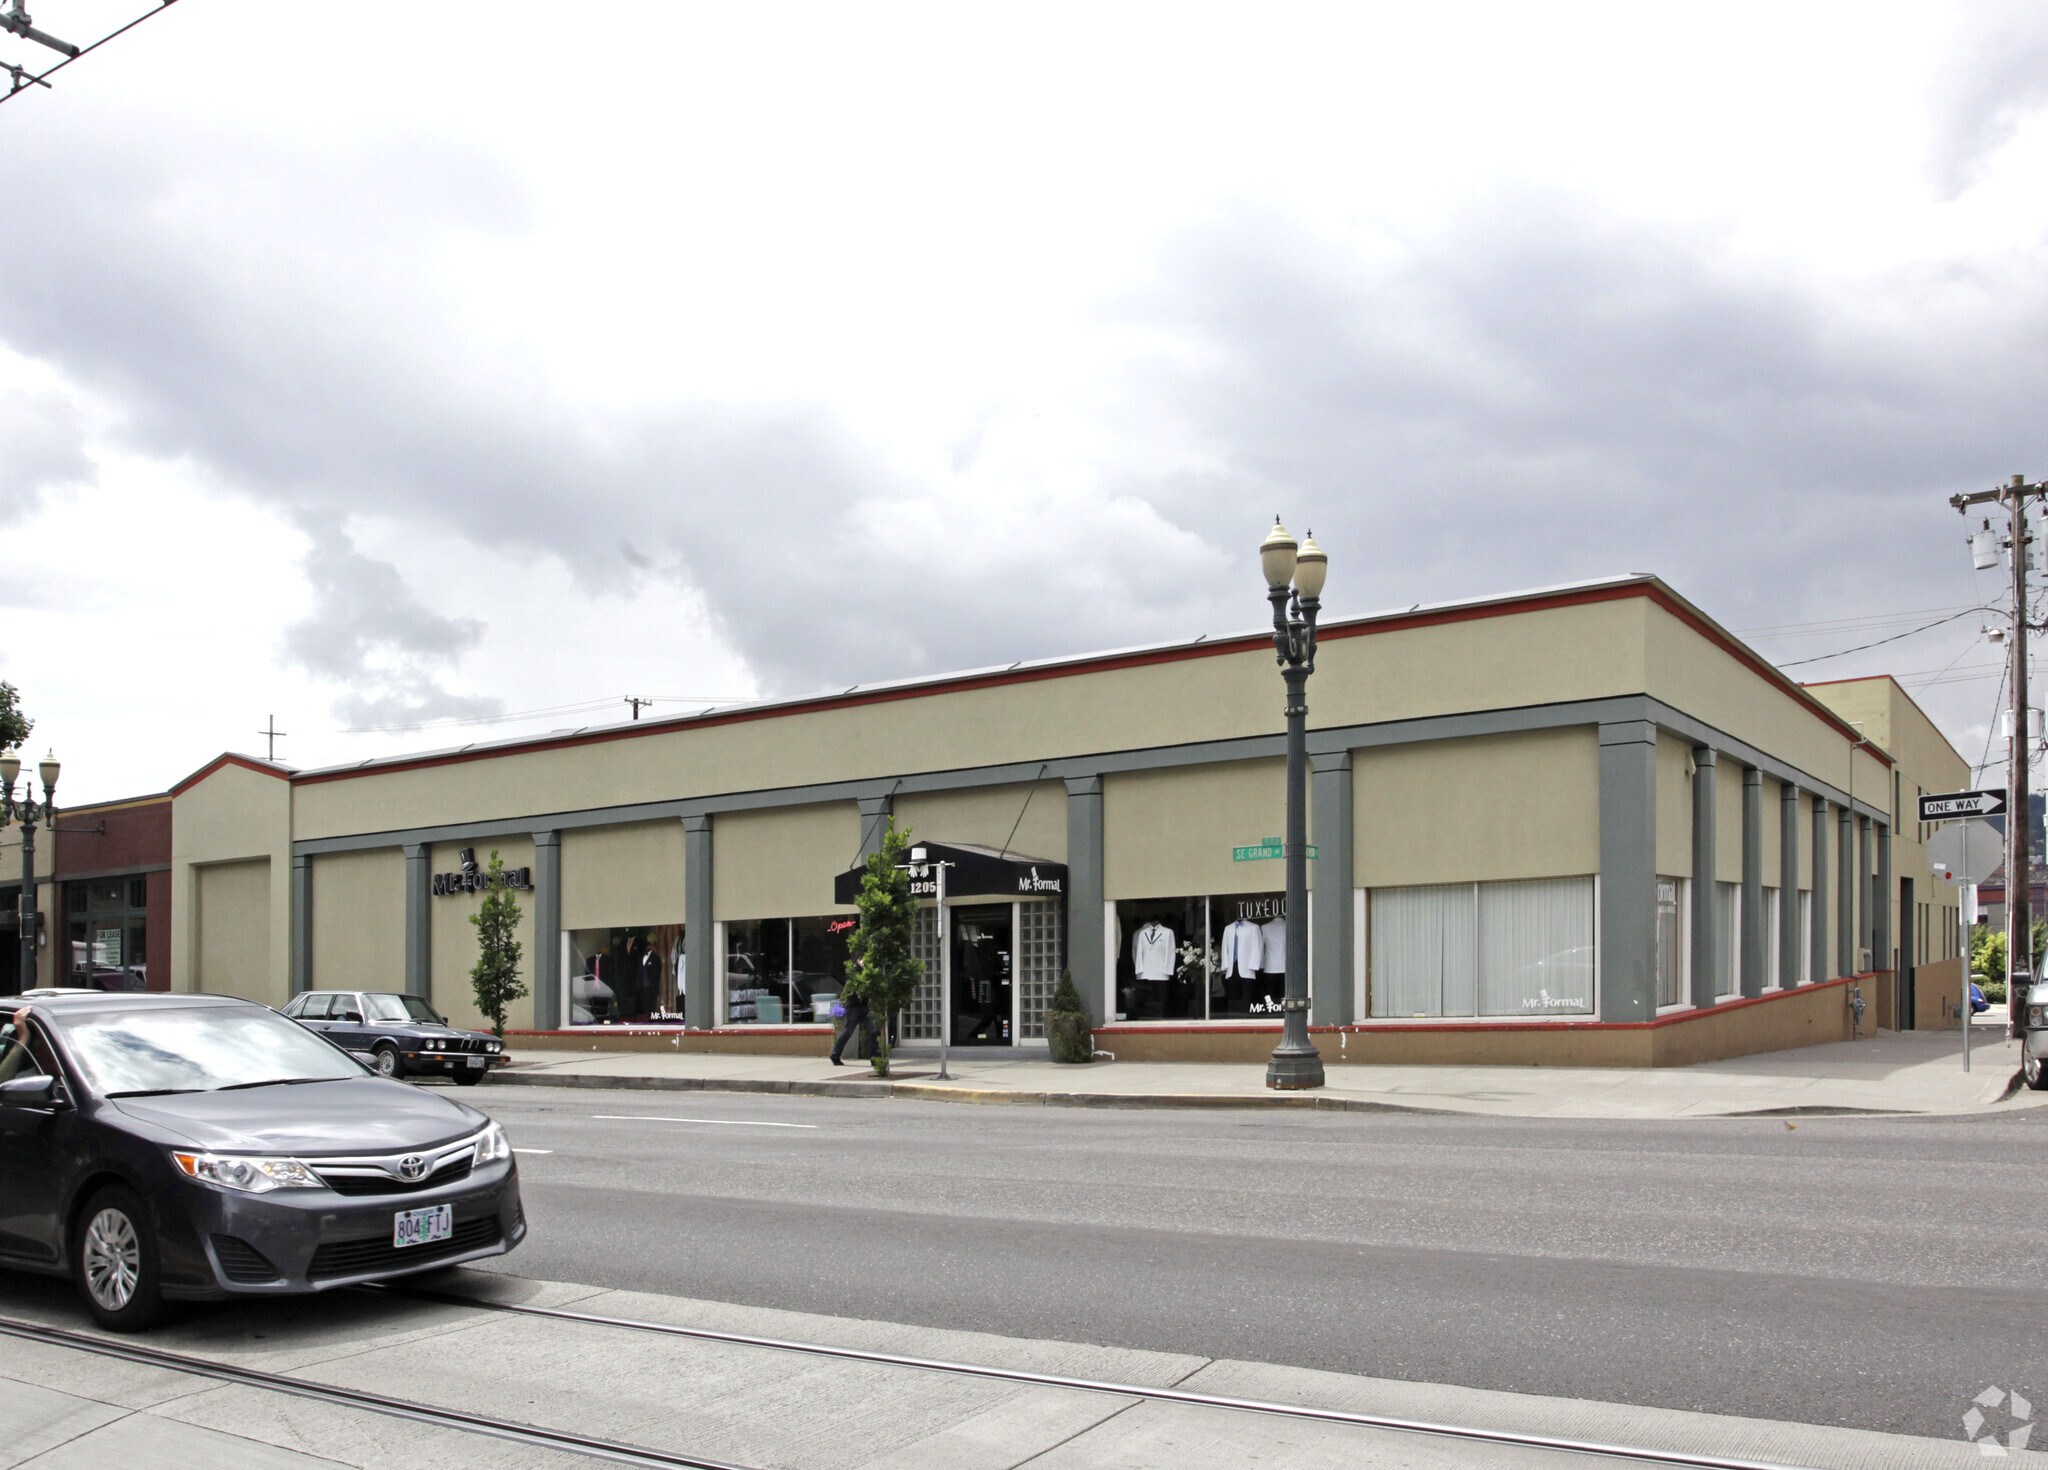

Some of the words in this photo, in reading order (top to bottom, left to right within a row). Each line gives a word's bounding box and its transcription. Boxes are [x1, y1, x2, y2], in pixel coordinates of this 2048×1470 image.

[1927, 801, 1951, 813] ONE
[1955, 799, 1980, 811] WAY
[1236, 848, 1245, 860] SE
[1248, 847, 1273, 859] GRAND
[433, 873, 463, 896] Mr.
[910, 881, 937, 894] 1205
[1018, 877, 1032, 891] Mr.
[96, 930, 106, 939] FOR
[107, 929, 121, 938] LEASE
[1249, 1003, 1265, 1013] Mr.
[1521, 998, 1541, 1008] Mr.
[650, 1012, 661, 1020] Mr.
[398, 1218, 420, 1239] 804
[427, 1213, 449, 1233] FTJ
